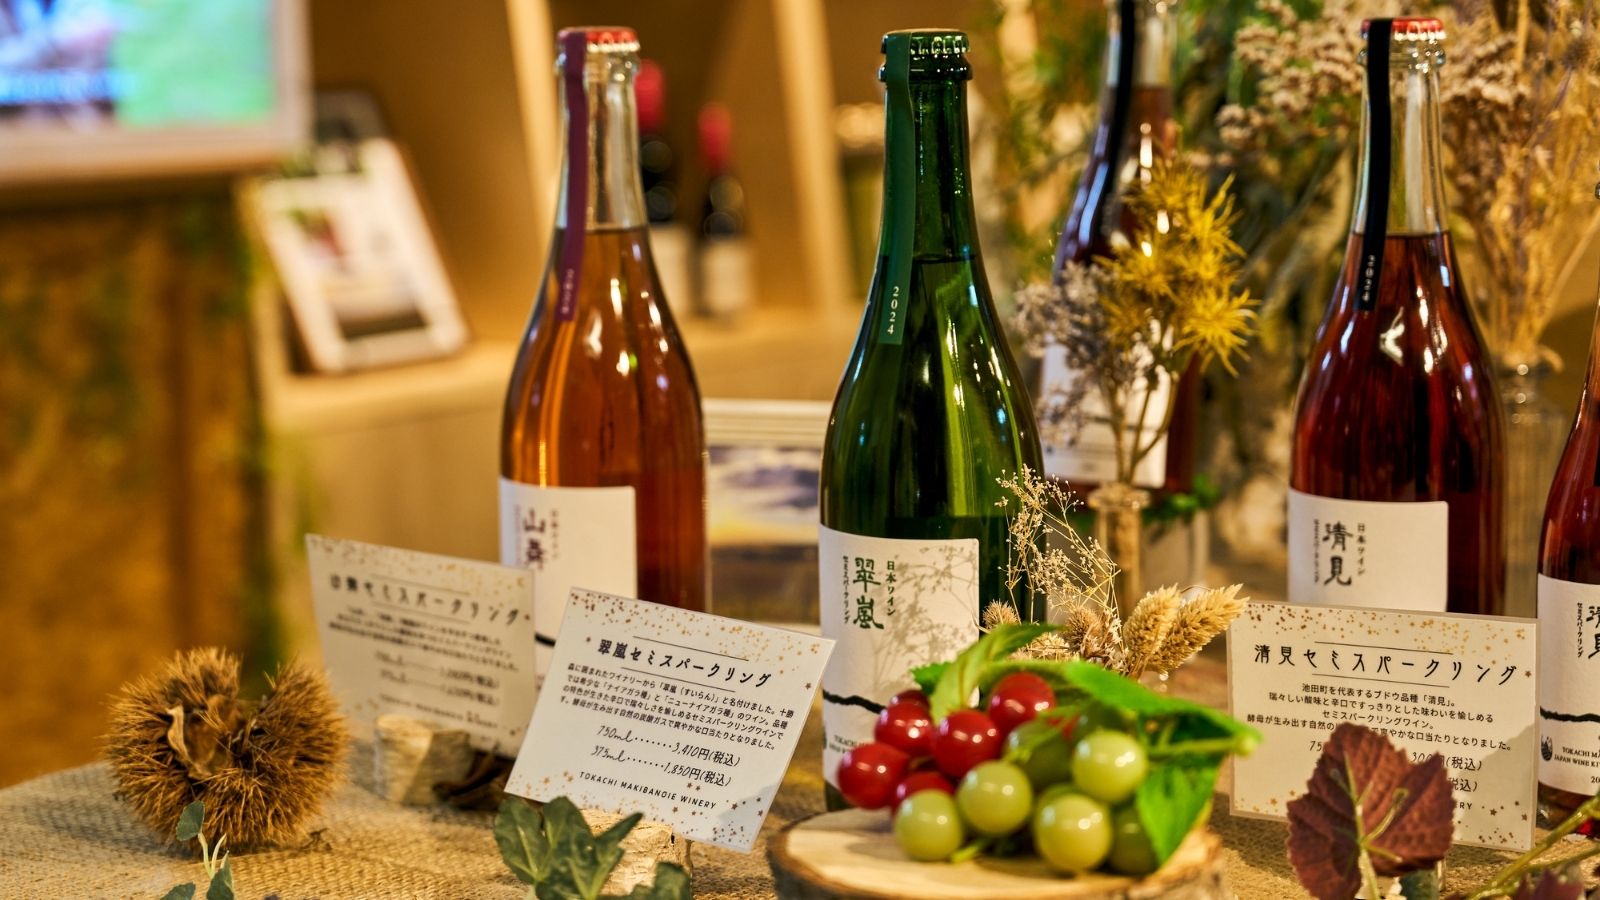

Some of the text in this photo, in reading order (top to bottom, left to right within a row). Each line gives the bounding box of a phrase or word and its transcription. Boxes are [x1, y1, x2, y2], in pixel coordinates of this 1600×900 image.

[887, 286, 900, 335] 2024
[1322, 521, 1354, 586] 清見
[1357, 523, 1366, 577] 日本ワイン
[852, 557, 884, 630] 翠嵐
[886, 560, 897, 617] 日本ワイン
[598, 638, 772, 688] 翠嵐セミスパークリング
[1254, 644, 1518, 686] 清見セミスパークリング
[1322, 709, 1434, 730] セミスパークリングワイン。
[1562, 746, 1590, 757] TOKACHI
[579, 771, 717, 810] TOKACHI MAKIBANOIE WINERY
